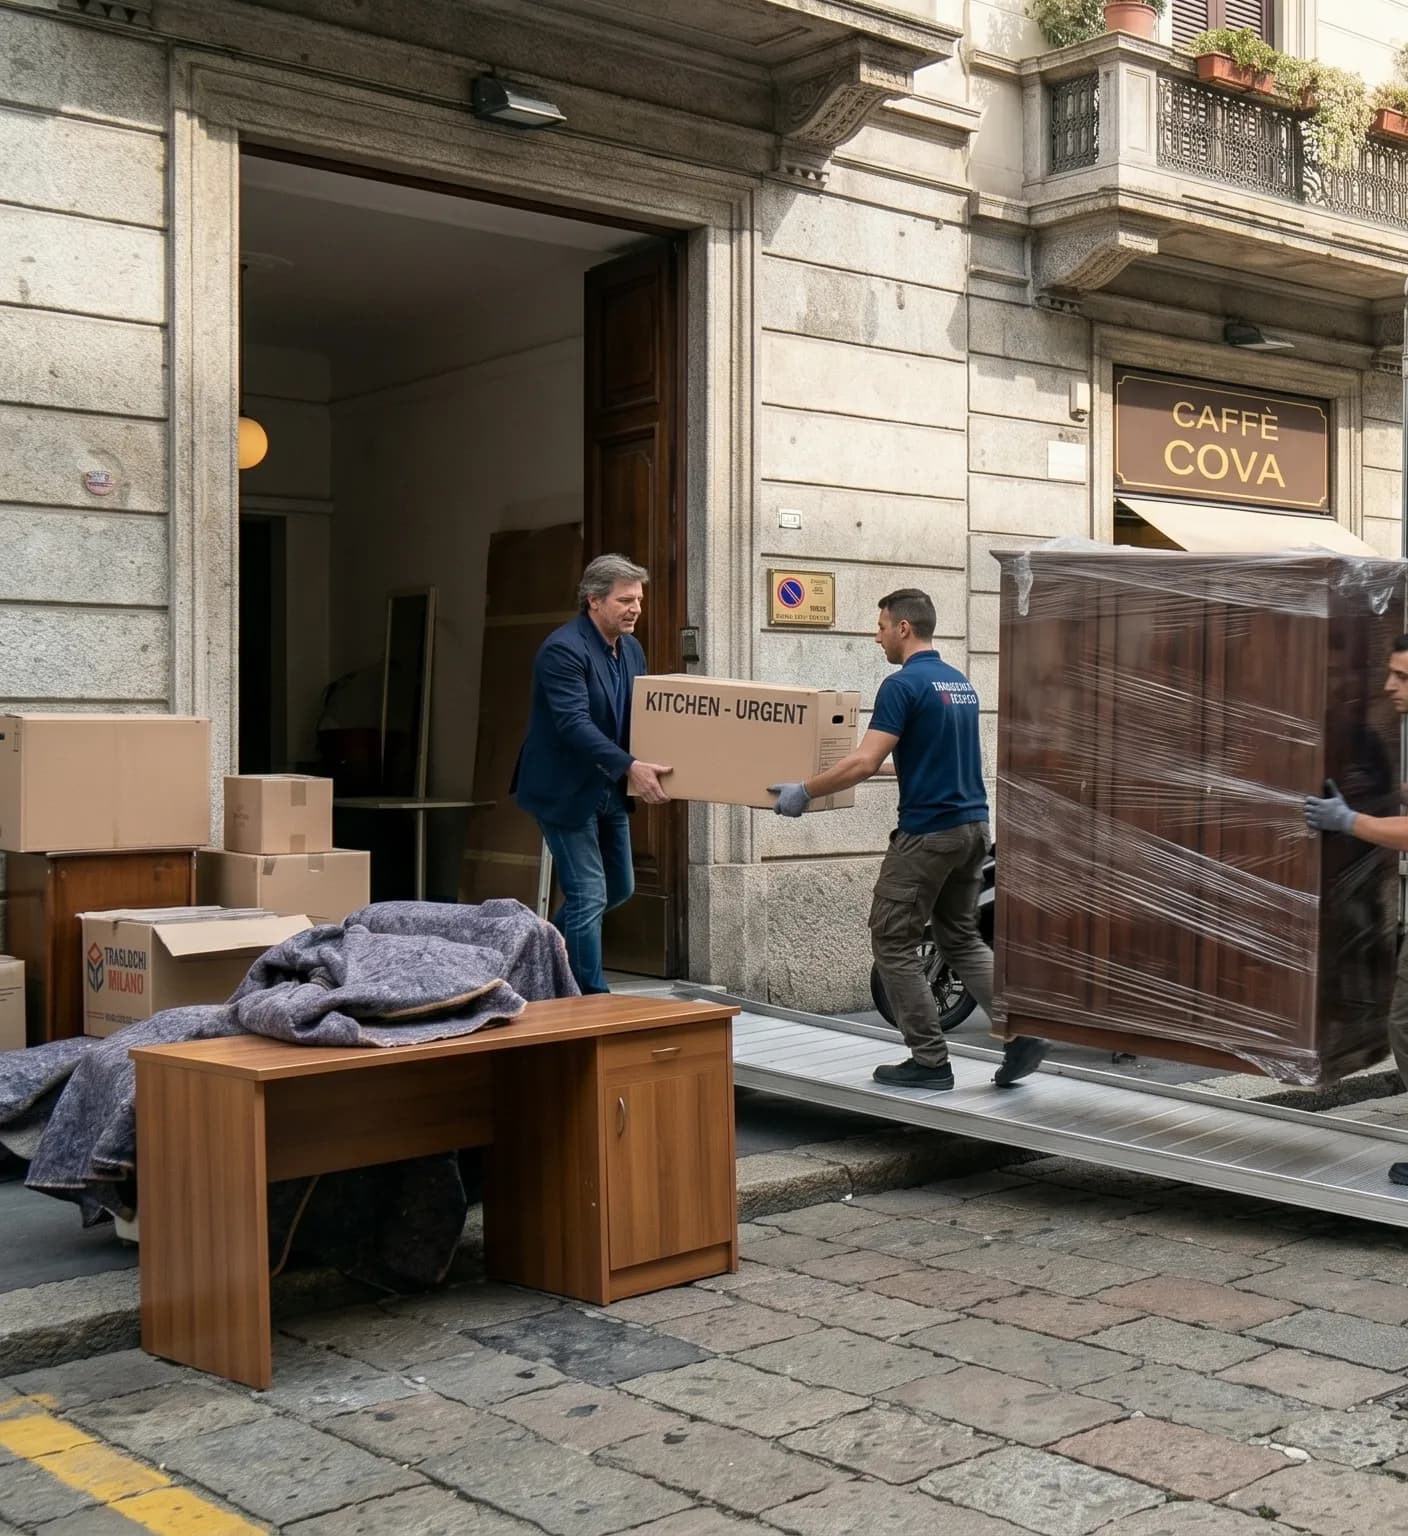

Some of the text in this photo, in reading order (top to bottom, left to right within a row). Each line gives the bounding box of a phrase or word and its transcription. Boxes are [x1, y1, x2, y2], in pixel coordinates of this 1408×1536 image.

[1172, 401, 1279, 441] CAFFÈ
[1164, 439, 1286, 488] COVA
[646, 691, 721, 717] KITCHEN
[735, 699, 808, 725] URGENT
[108, 969, 143, 994] MILANO
